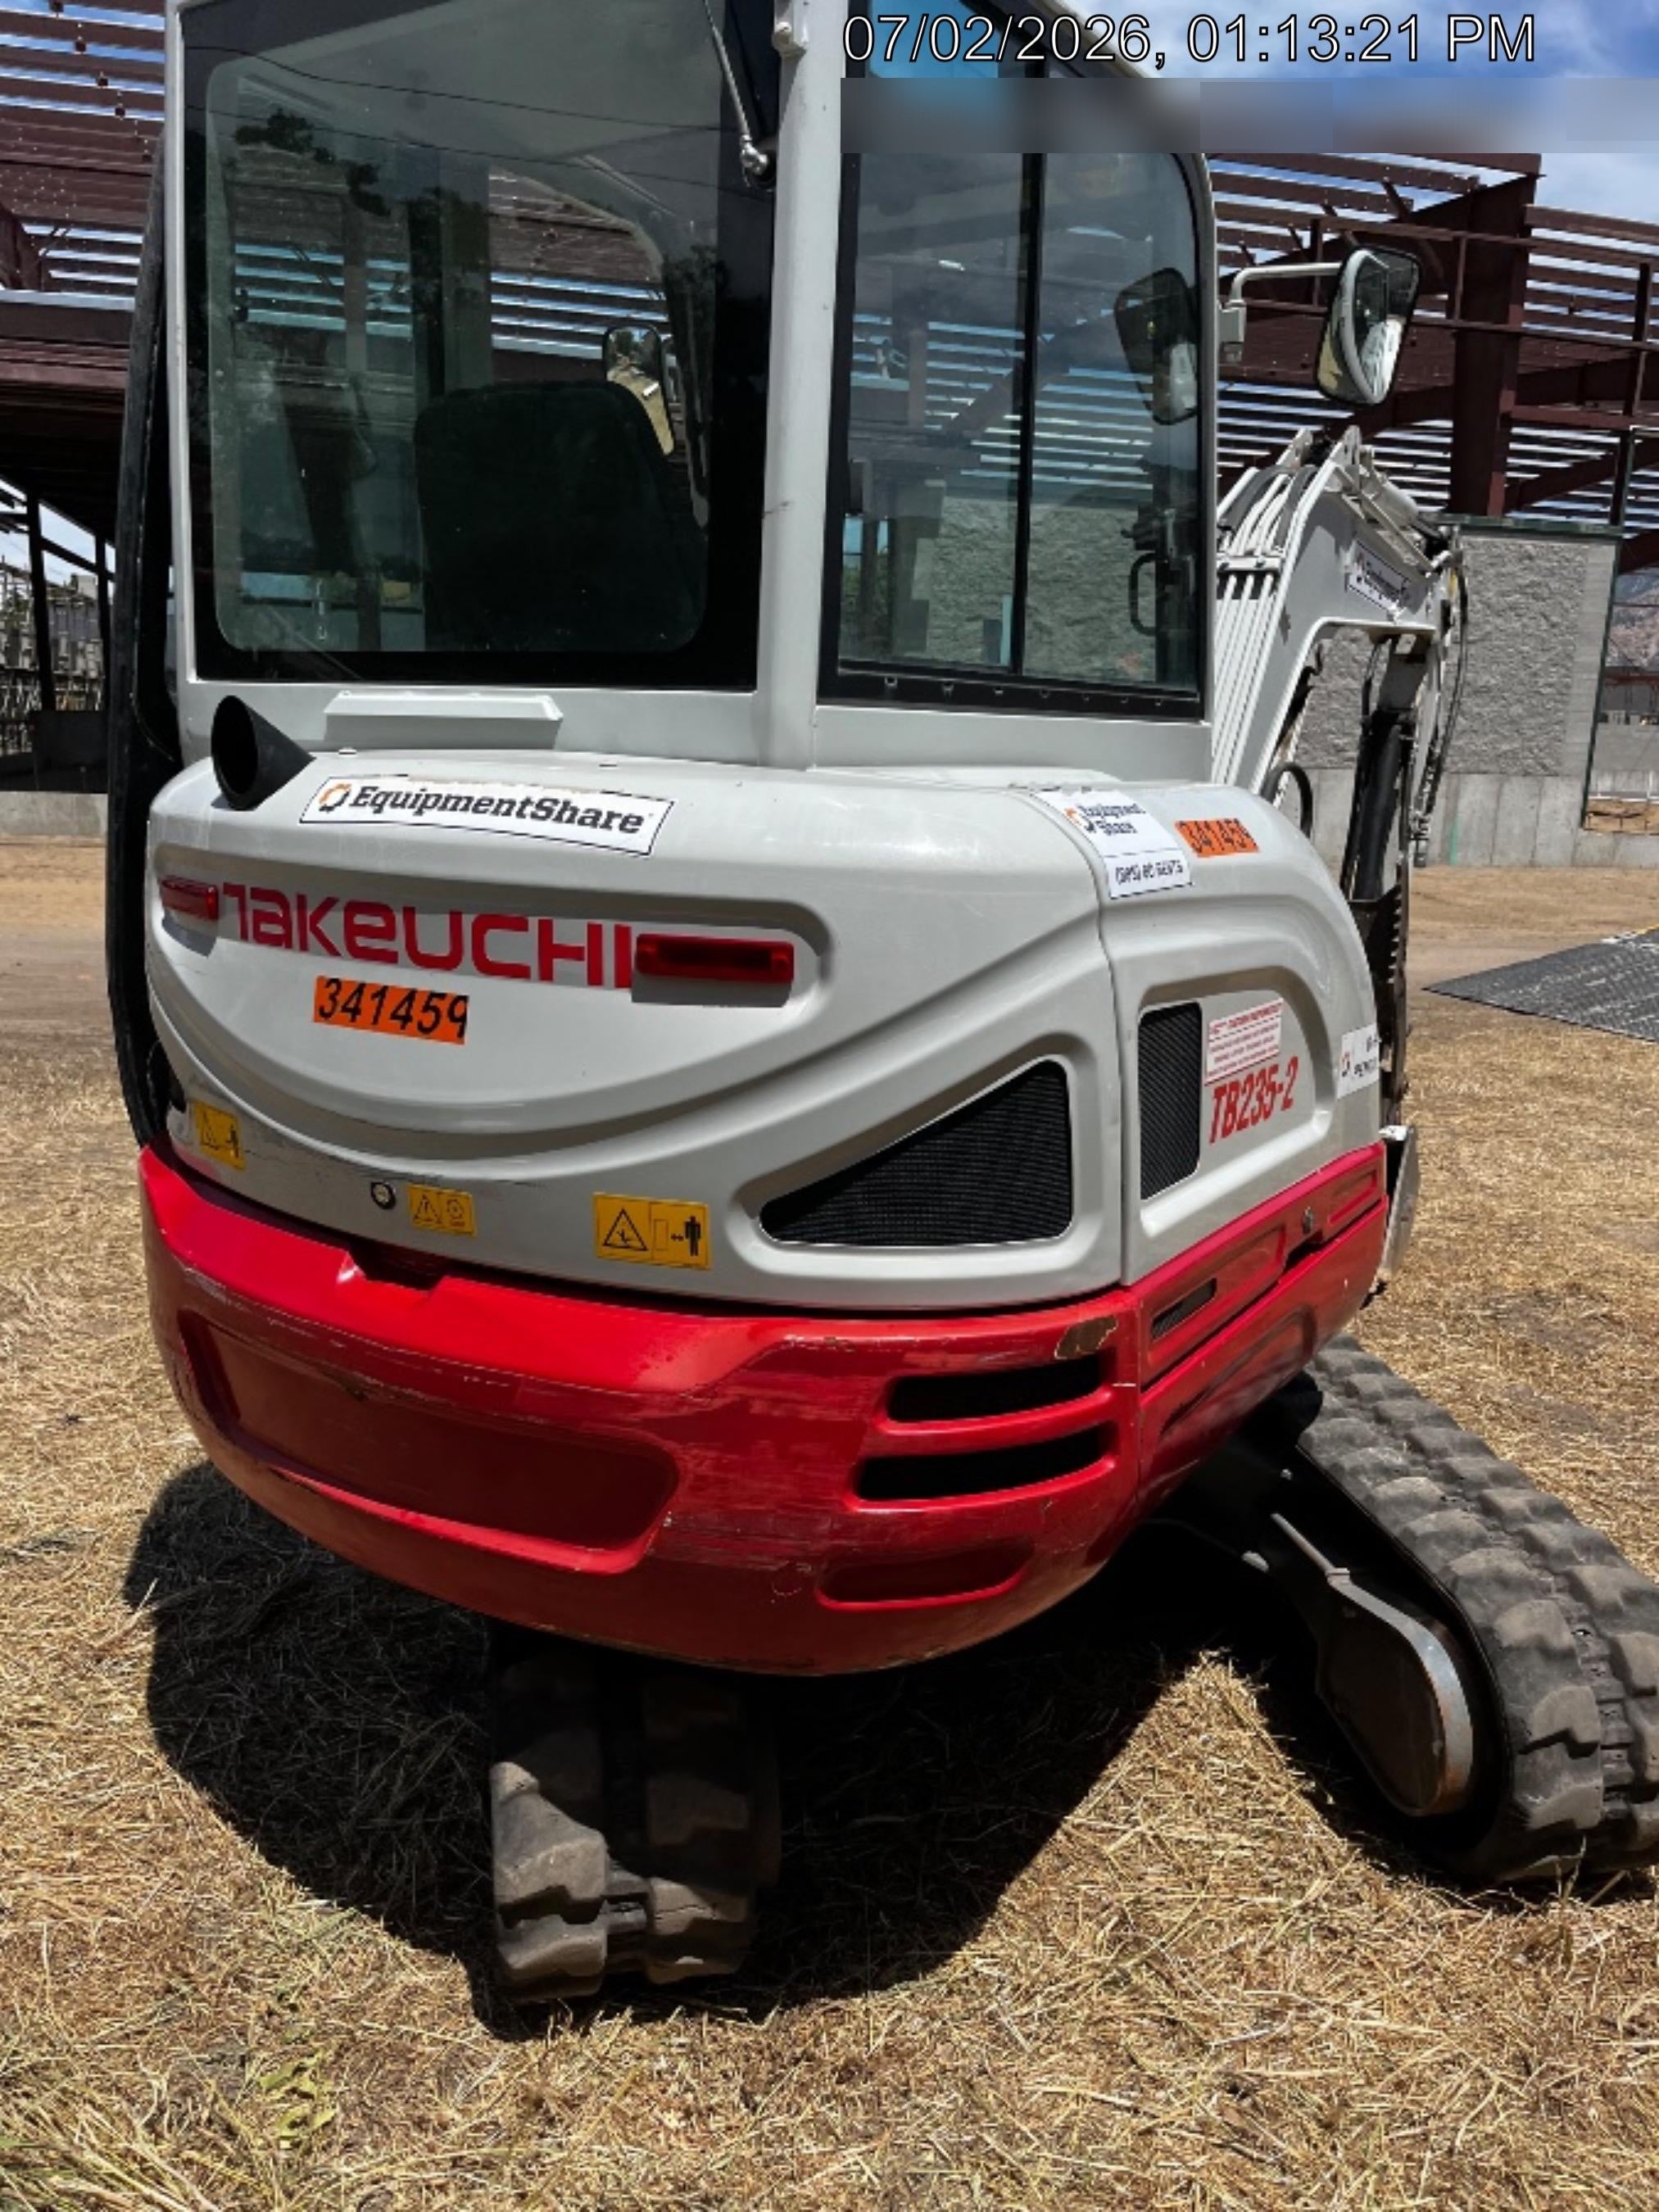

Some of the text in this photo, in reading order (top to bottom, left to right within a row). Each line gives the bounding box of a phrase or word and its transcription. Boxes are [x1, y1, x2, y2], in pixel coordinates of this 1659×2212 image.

[351, 784, 645, 834] EquipmentShare
[319, 978, 469, 1039] 341459
[1209, 1056, 1299, 1144] TB235-2
